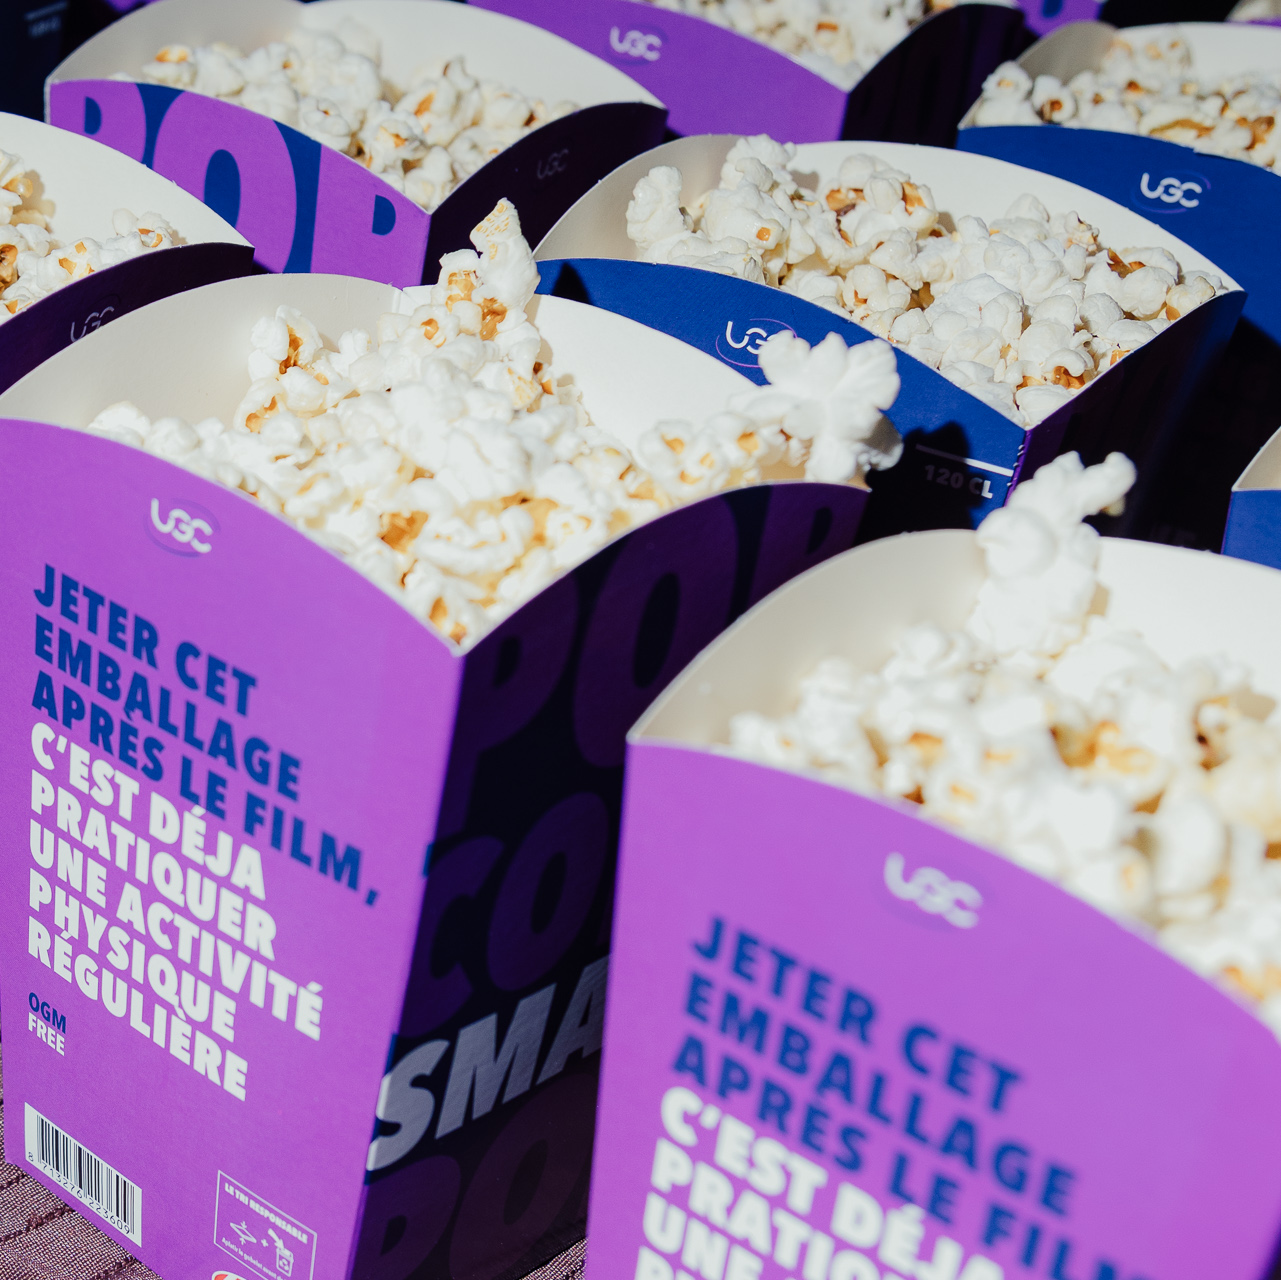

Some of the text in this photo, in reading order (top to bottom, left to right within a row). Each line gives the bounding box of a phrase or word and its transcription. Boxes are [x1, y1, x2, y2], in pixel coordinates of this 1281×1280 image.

[609, 25, 663, 62] UGC
[1140, 172, 1203, 208] UGC
[150, 497, 213, 553] UGC
[924, 463, 994, 500] 120 CL
[33, 563, 160, 670] JETER
[175, 641, 258, 718] CET
[35, 613, 302, 802] EMBALLAGE
[31, 722, 267, 902] C'EST DÉJA
[31, 769, 277, 962] PRATIQUER
[180, 755, 228, 820] LE
[243, 793, 382, 908] FILM,
[29, 820, 108, 910] UNE
[116, 884, 324, 1041] ACTIVITÉ
[883, 852, 985, 929] UGC
[28, 916, 250, 1102] RÉGULIÈRE
[28, 991, 67, 1035] OGM
[29, 868, 237, 1044] PHYSIQUE
[691, 915, 1025, 1114] JETER CET
[28, 1012, 66, 1057] FREE
[682, 970, 1078, 1218] EMBALLAGE
[88, 1197, 130, 1235] 223609
[661, 1086, 828, 1216] C'EST
[890, 1151, 962, 1225] LE
[249, 1199, 308, 1244] RESPONSABLE
